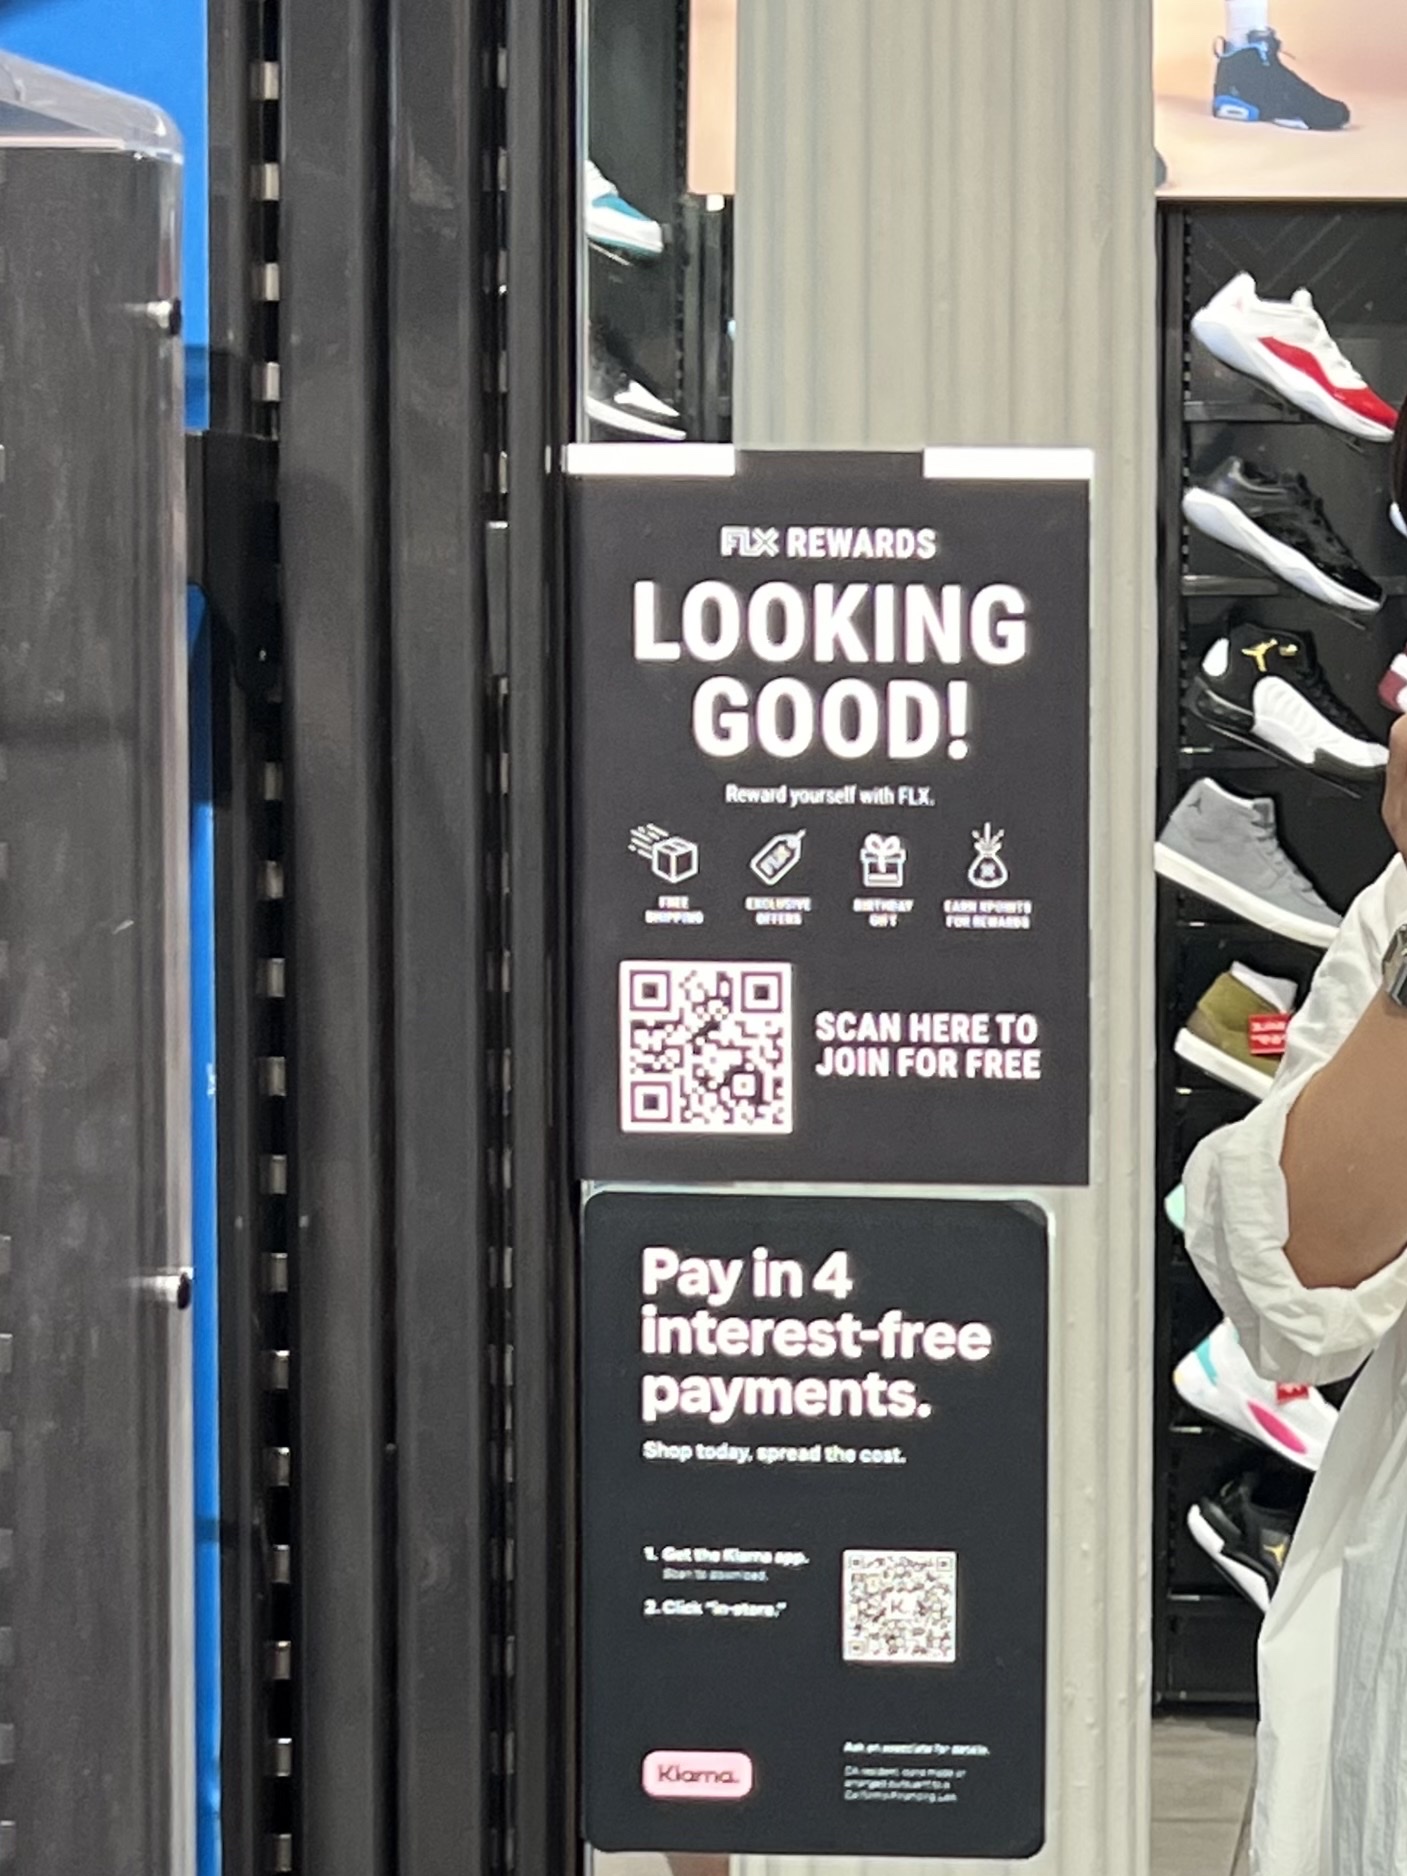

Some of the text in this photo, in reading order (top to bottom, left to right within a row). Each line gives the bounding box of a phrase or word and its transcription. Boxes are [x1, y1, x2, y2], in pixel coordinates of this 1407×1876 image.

[720, 525, 937, 560] FLX REWARDS
[634, 580, 1027, 666] LOOKING
[693, 676, 969, 760] GOOD!
[725, 783, 935, 808] Reward yourself with FLX.
[815, 1010, 1039, 1045] SCAN HERE TO
[815, 1046, 1042, 1080] JOIN FOR FREE
[642, 1246, 854, 1307] Pay in 4
[642, 1303, 992, 1361] interest-free
[642, 1372, 932, 1425] payments.
[642, 1440, 907, 1465] Shop today, spread the cost.
[661, 1546, 693, 1563] Get
[692, 1547, 722, 1563] the
[643, 1598, 662, 1616] 2.
[660, 1599, 704, 1616] Click
[656, 1764, 740, 1783] Klarna.
